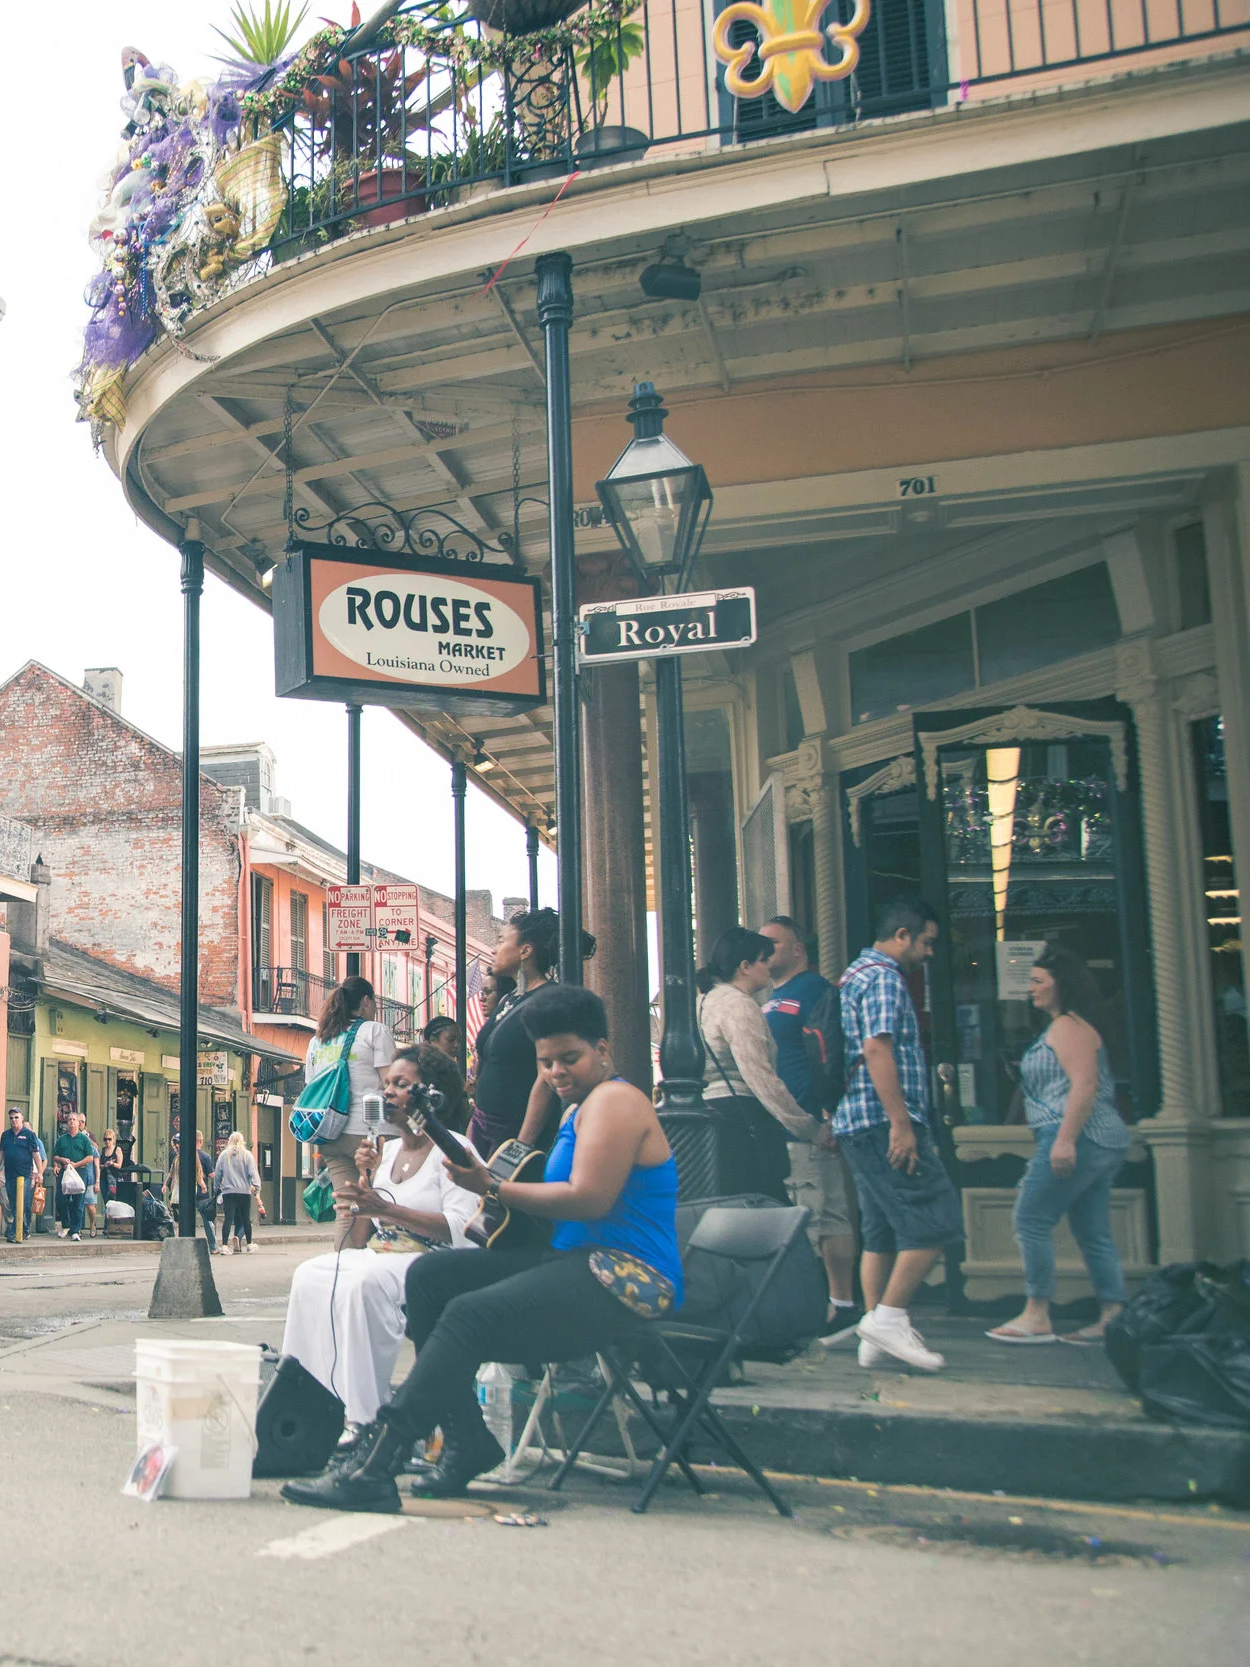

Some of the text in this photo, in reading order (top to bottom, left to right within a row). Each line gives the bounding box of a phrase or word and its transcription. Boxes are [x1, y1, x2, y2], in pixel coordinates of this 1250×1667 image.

[899, 476, 936, 496] 701
[635, 599, 697, 612] Rue Royale
[346, 586, 494, 639] ROUSES
[616, 610, 718, 648] Royal
[438, 641, 506, 661] MARKET
[366, 652, 490, 677] Louisiana Owned
[329, 890, 370, 903] NO PARKING
[374, 890, 417, 903] NO STOPPING
[331, 909, 368, 918] FREIGHT
[391, 908, 402, 916] TO
[338, 920, 361, 929] ZONE
[379, 918, 414, 926] CORNER
[200, 1077, 213, 1085] 710
